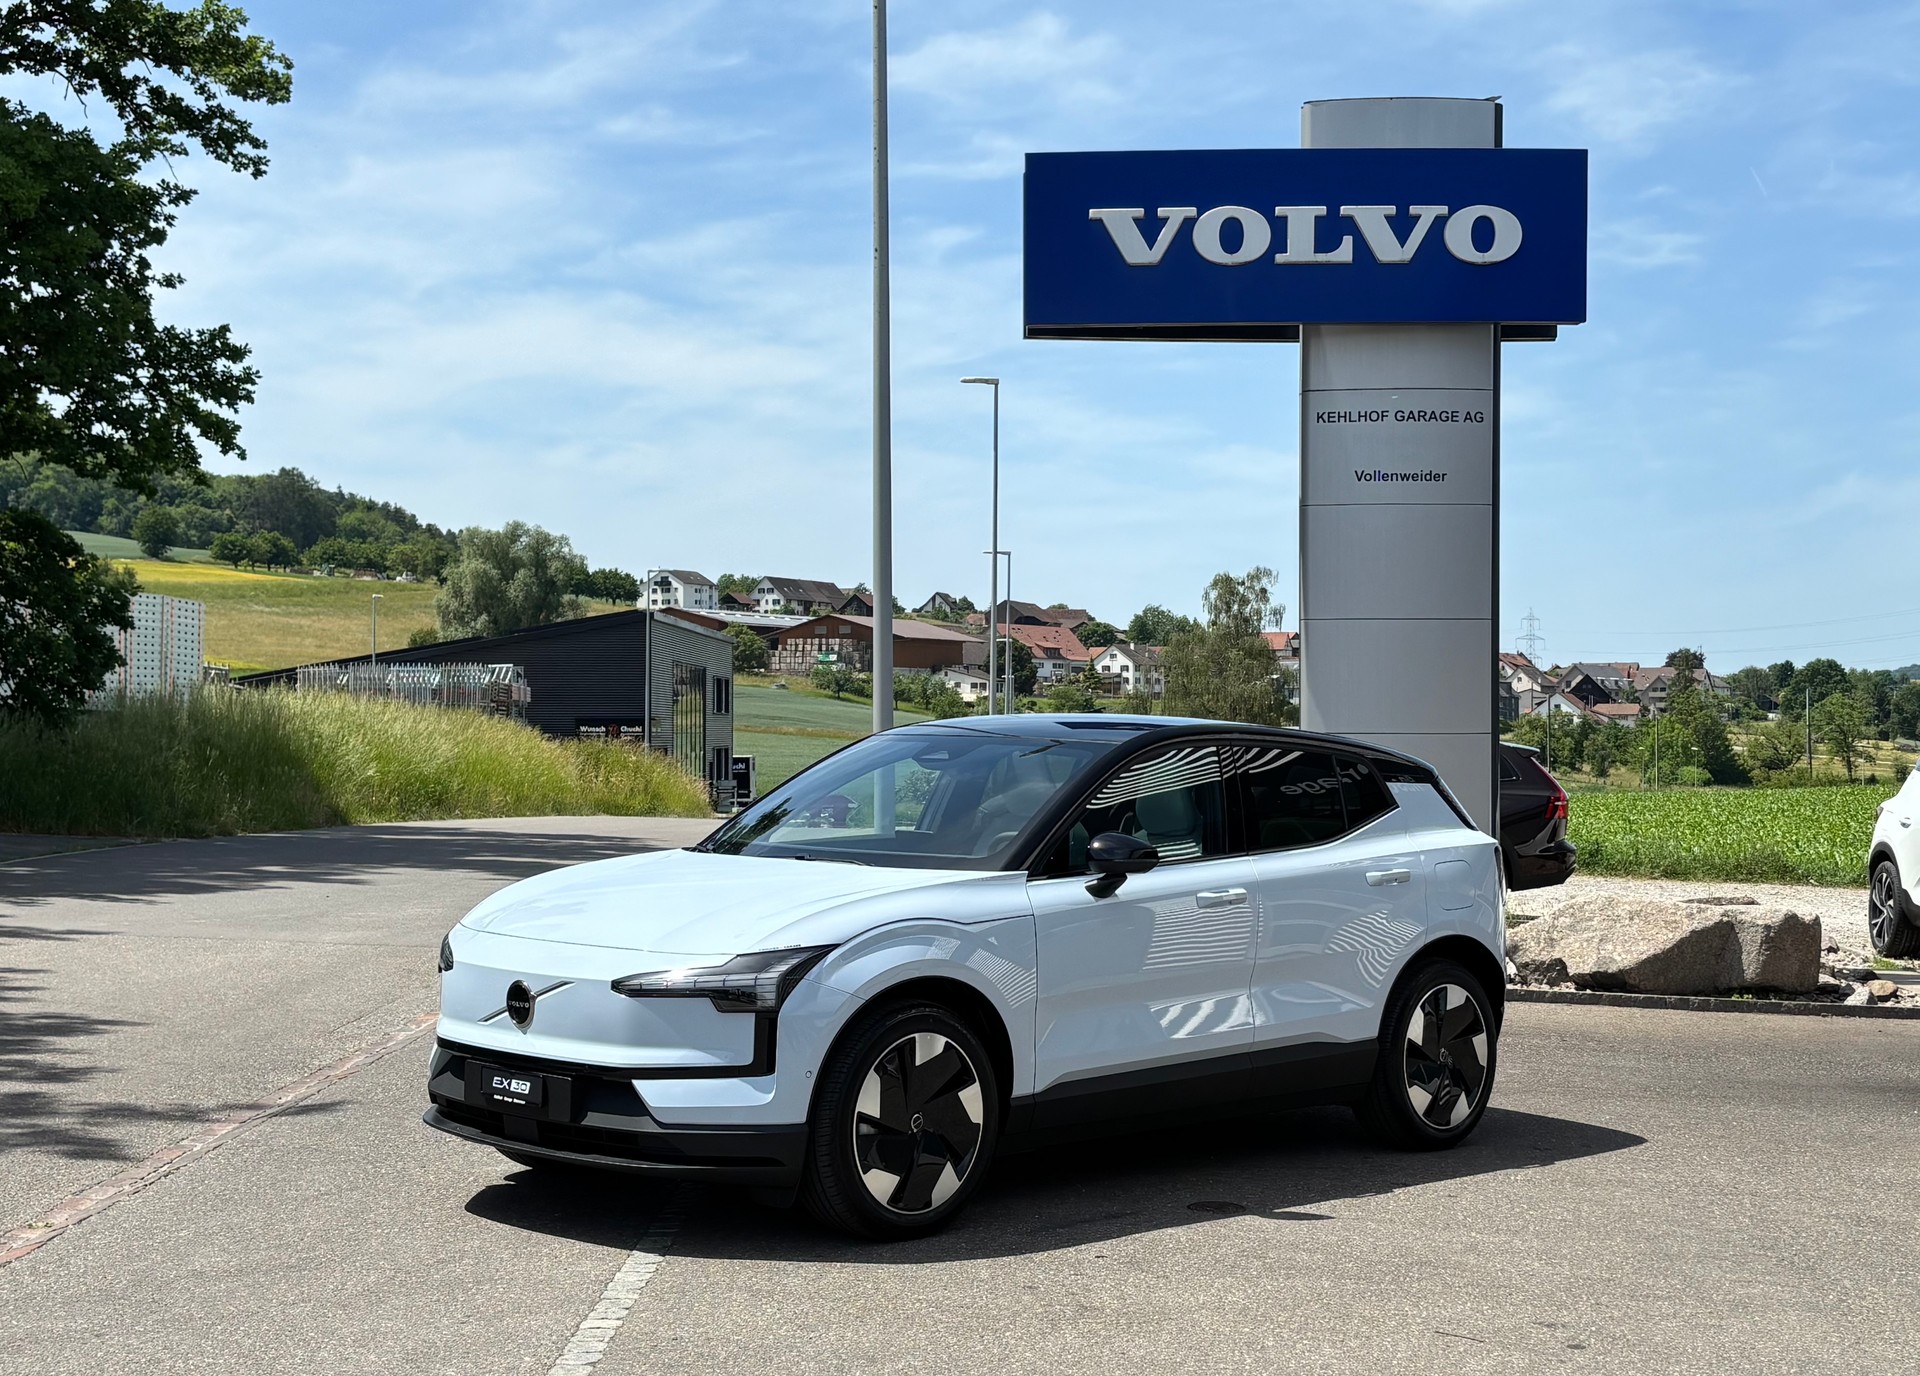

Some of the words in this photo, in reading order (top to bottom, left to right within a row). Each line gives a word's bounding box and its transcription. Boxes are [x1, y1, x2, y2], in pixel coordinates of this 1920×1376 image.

[1089, 204, 1523, 267] VOLVO
[1316, 410, 1389, 424] KEHLHOF
[1394, 410, 1459, 423] GARAGE
[1463, 411, 1484, 423] AG
[1354, 470, 1447, 482] Vollenweider
[508, 1000, 530, 1009] VOLVO
